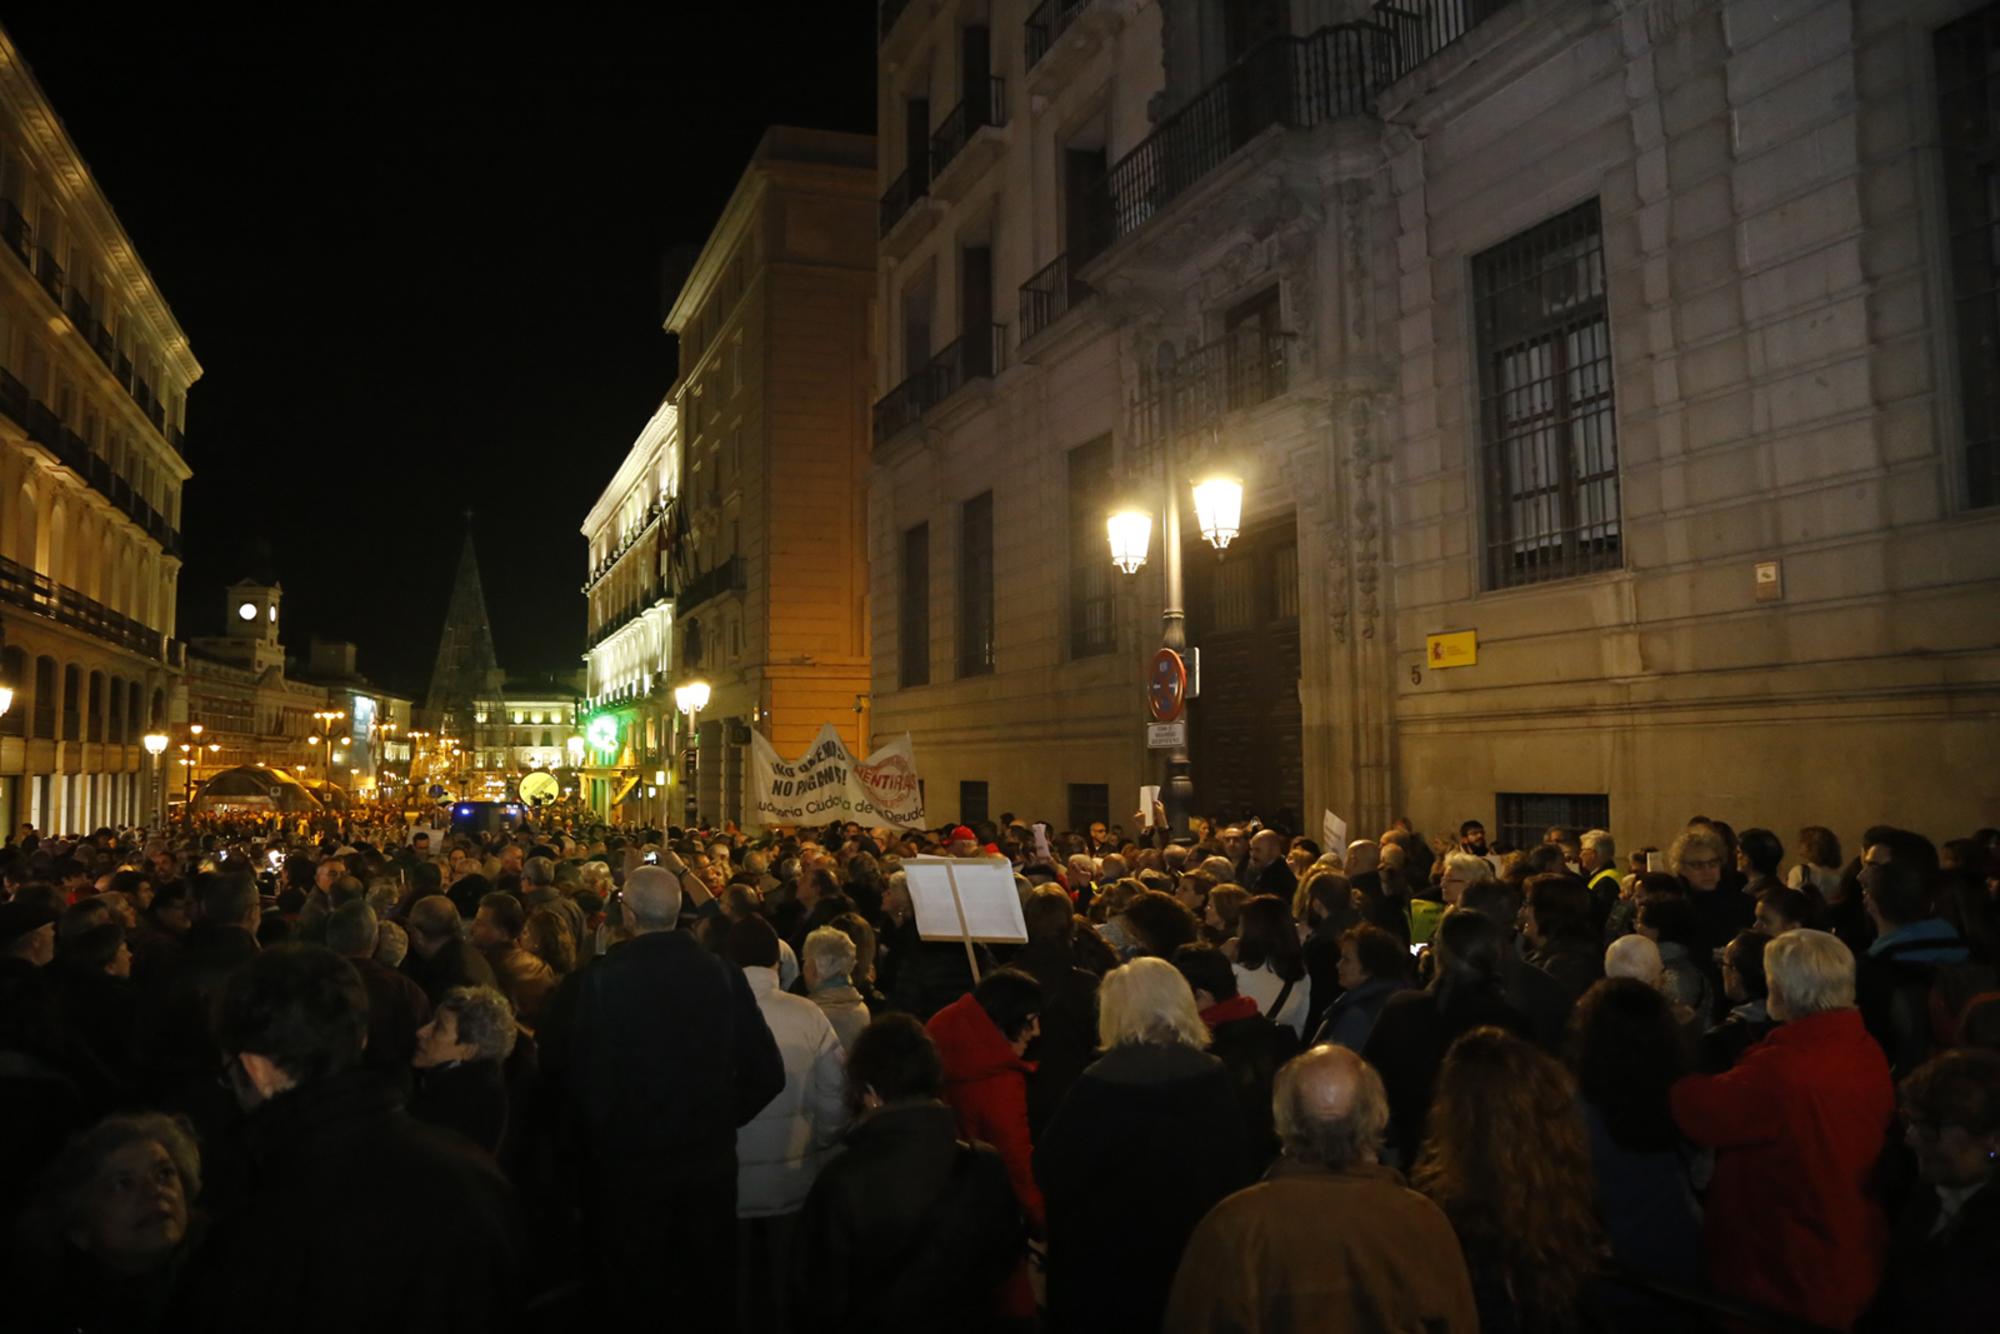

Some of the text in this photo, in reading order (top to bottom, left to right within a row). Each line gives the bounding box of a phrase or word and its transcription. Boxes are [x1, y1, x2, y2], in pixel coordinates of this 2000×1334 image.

[1411, 664, 1422, 686] 5
[772, 780, 793, 797] NO
[854, 802, 874, 816] de
